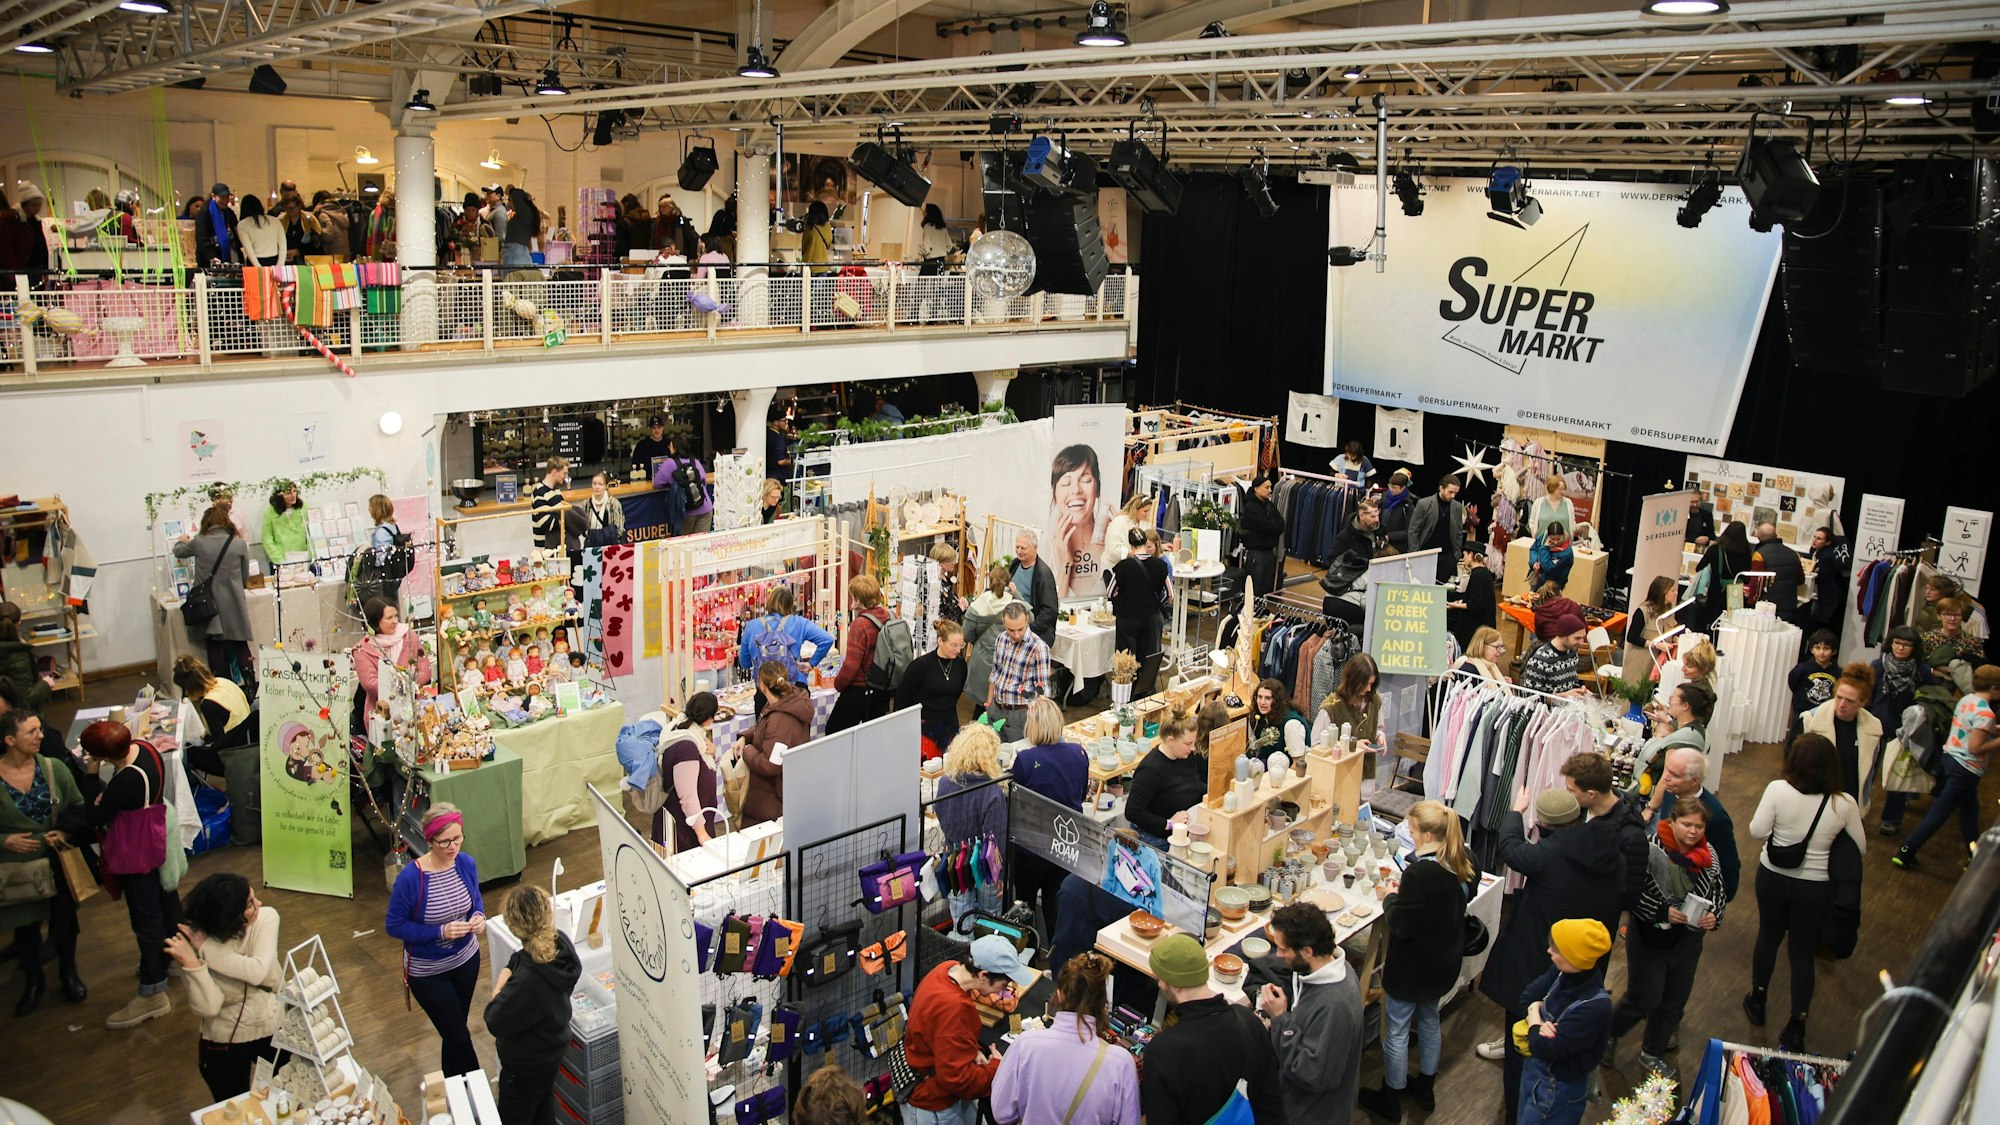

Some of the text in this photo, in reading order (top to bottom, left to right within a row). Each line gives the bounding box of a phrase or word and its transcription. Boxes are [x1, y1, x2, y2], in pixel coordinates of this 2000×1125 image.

[1439, 257, 1595, 334] SUPER
[1498, 328, 1604, 364] MARKT
[1502, 359, 1517, 369] Design
[1418, 394, 1500, 414] @DERSUPERMARKT
[1517, 409, 1613, 430] @DERSUPERMARKT
[1073, 550, 1091, 563] So
[1065, 561, 1098, 575] fresh
[1387, 589, 1434, 604] IT'S ALL
[1385, 604, 1428, 619] GREEK
[1384, 619, 1429, 634] TO ME.
[1381, 639, 1423, 654] AND I
[1380, 654, 1428, 669] LIKE IT.
[265, 683, 285, 696] Kölner
[316, 814, 324, 822] die
[288, 823, 296, 831] die
[304, 827, 324, 836] gemacht
[325, 828, 336, 836] sind
[1051, 838, 1080, 863] ROAM
